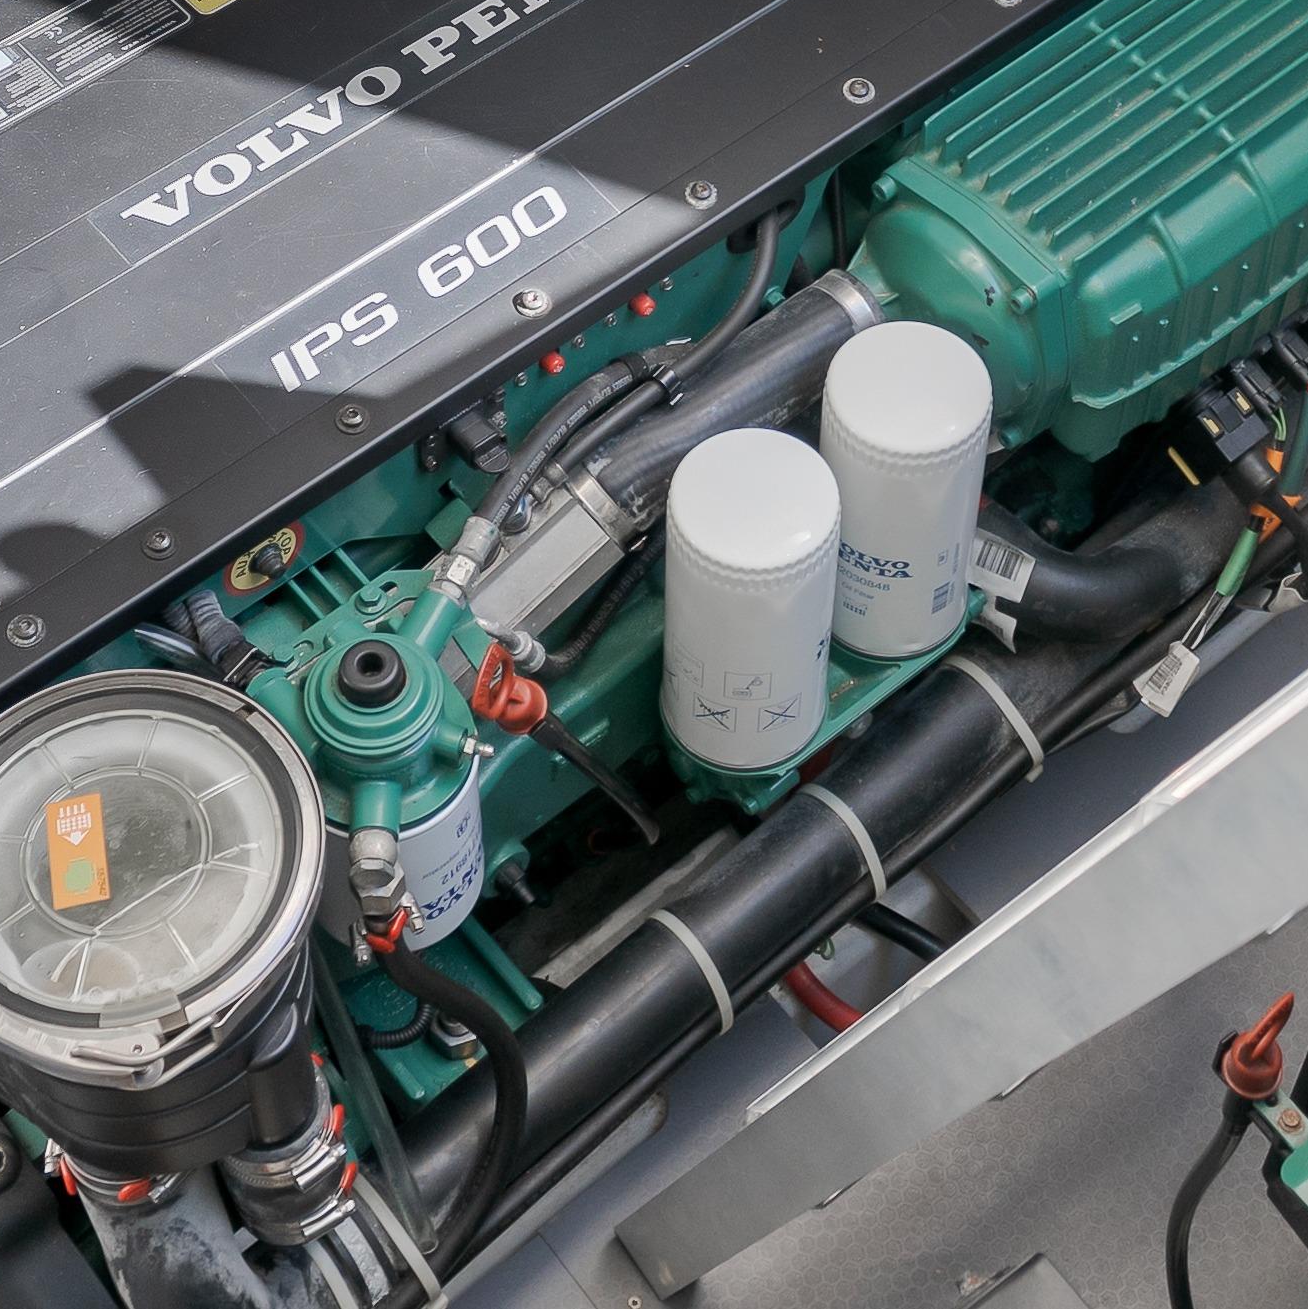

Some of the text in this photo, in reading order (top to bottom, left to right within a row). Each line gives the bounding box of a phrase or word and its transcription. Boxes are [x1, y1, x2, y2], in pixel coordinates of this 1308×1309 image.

[120, 66, 401, 227] VOLVO
[269, 292, 400, 393] IPS
[416, 185, 569, 299] 600
[268, 532, 291, 555] STOP
[839, 540, 910, 570] OLVO
[839, 547, 913, 578] ENTA
[837, 564, 890, 592] 2030848
